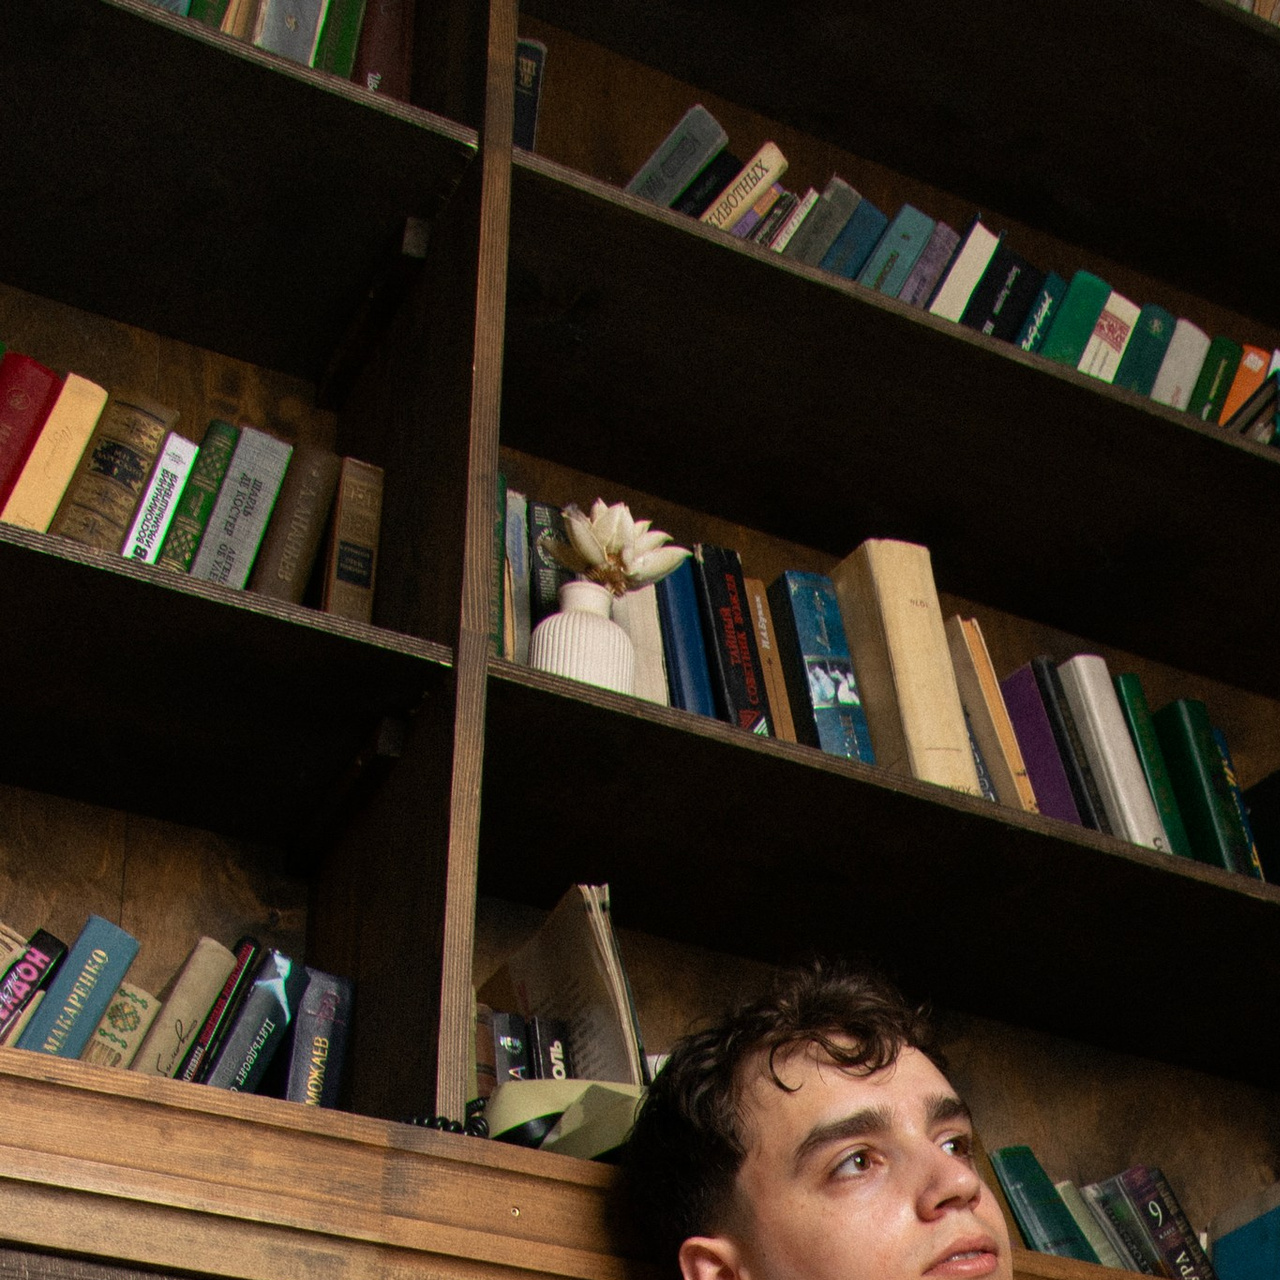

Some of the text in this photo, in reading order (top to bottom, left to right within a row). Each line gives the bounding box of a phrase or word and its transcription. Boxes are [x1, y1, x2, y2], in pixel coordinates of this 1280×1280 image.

[136, 467, 171, 544] ВОСПОМИНАНИЯ
[223, 472, 252, 536] ДЕ КОСТЕР
[242, 477, 263, 517] ШАРЛЬ
[720, 607, 741, 665] ТАЙНЫЙ
[737, 631, 759, 705] СОВЕТНИК
[43, 949, 109, 1053] МАКАРЕНКО
[305, 1036, 330, 1106] МОЖАЕВ
